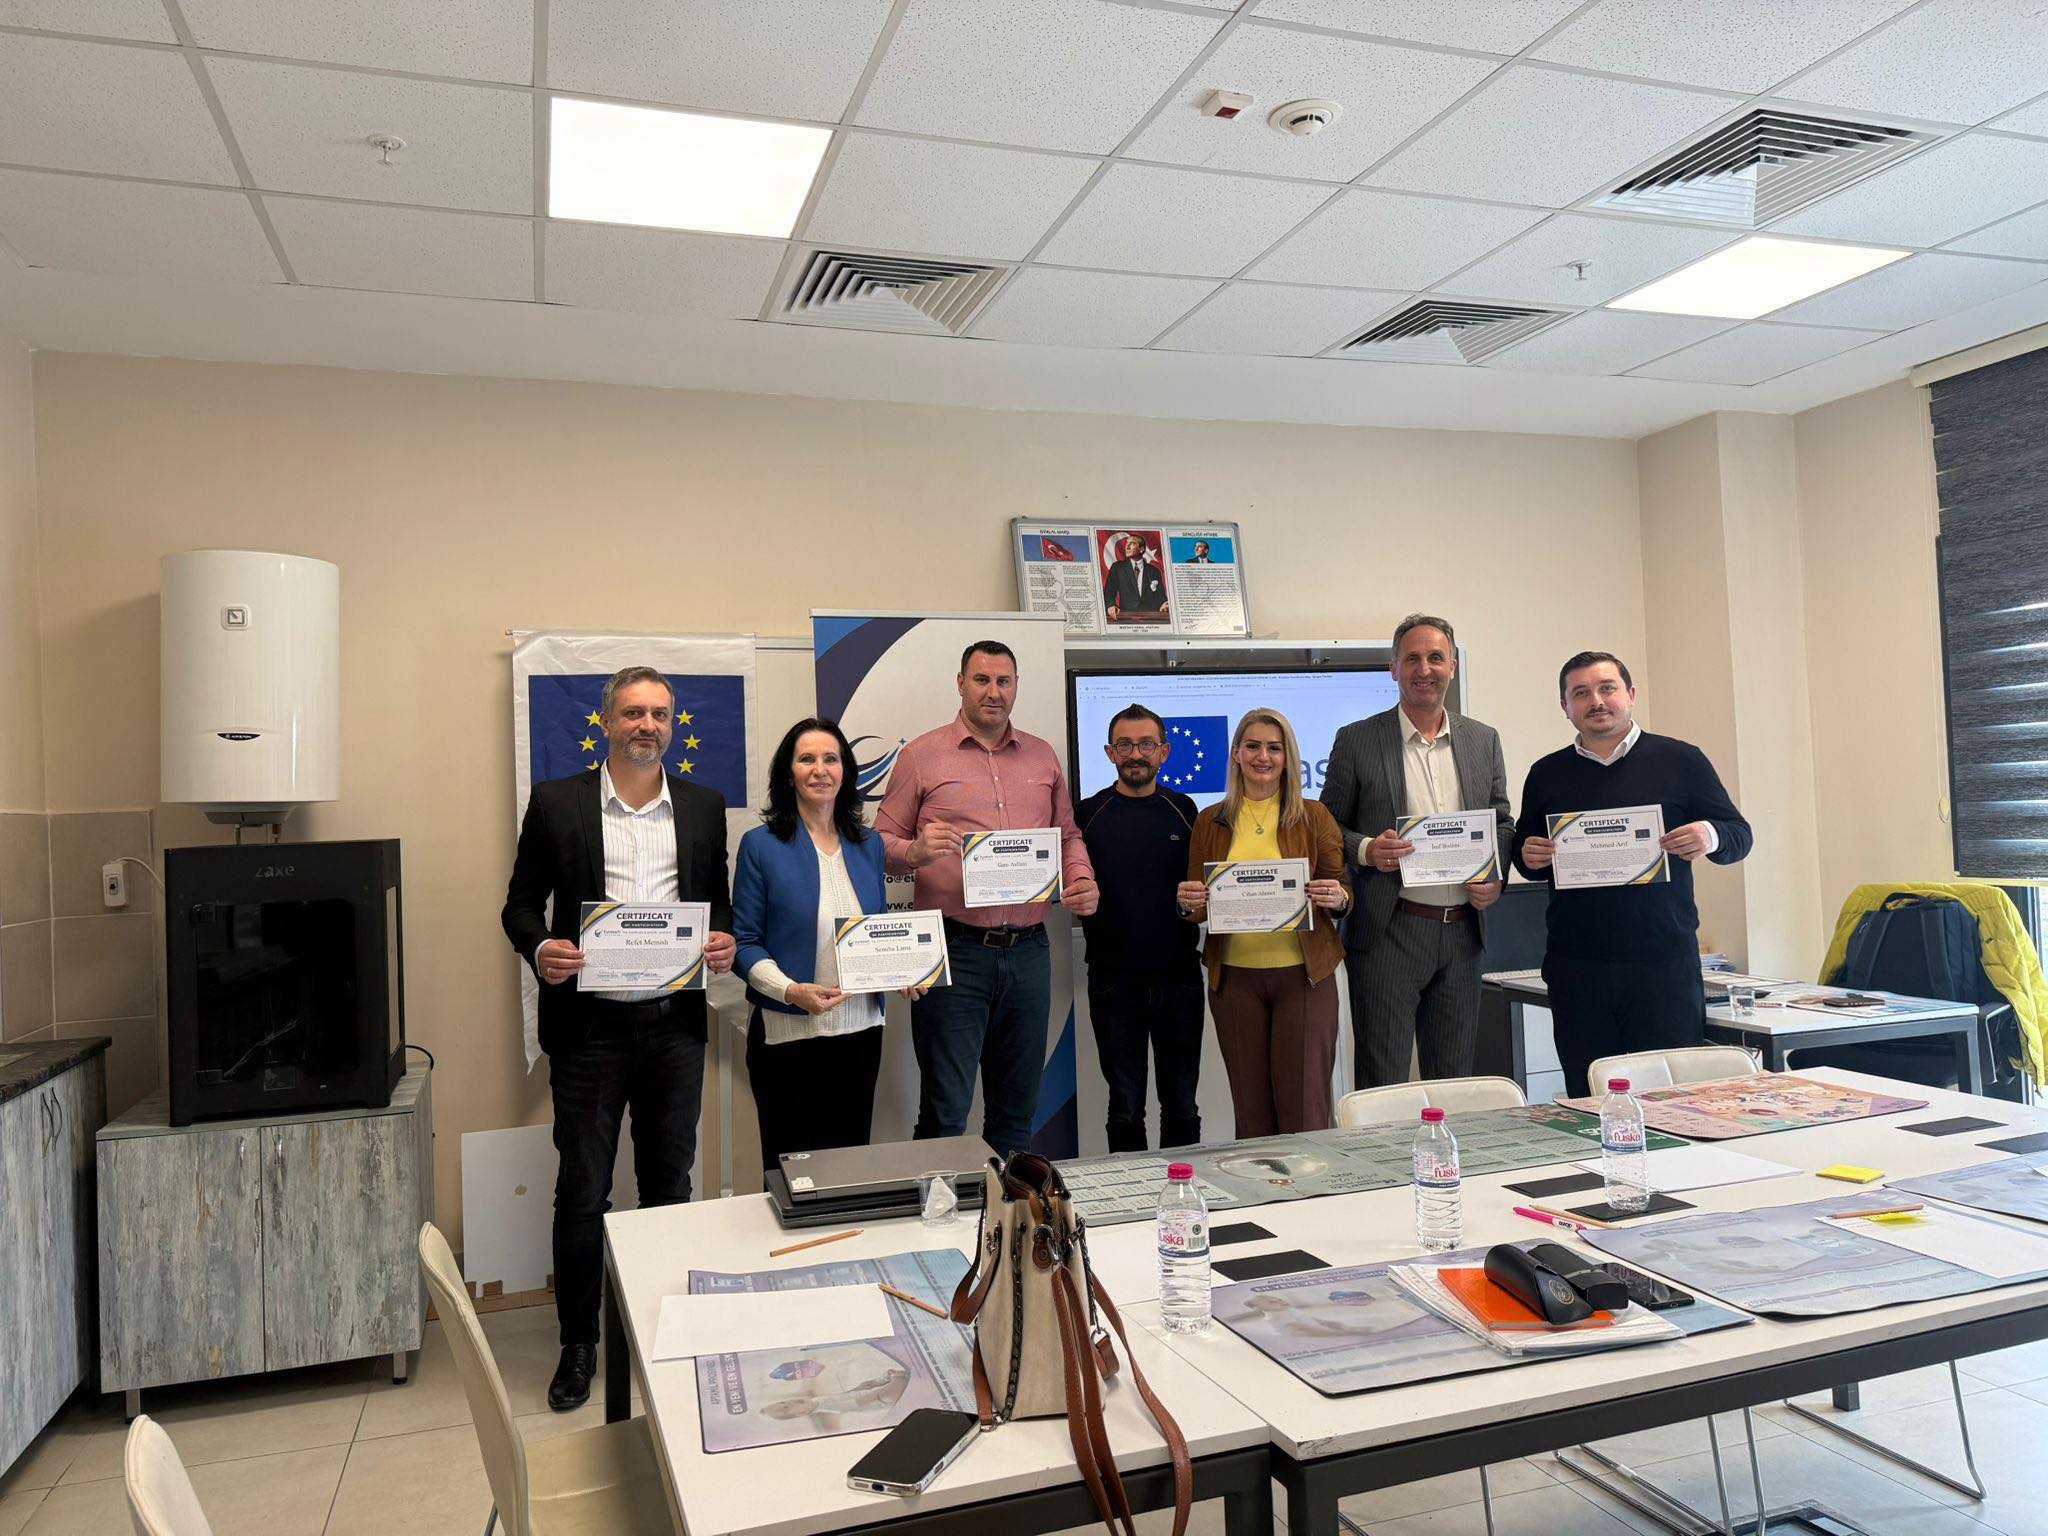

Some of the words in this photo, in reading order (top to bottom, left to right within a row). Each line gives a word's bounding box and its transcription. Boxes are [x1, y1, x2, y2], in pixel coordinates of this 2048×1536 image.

[1423, 821, 1467, 829] CERTIFICATE
[1579, 818, 1630, 827] CERTIFICATE
[864, 922, 912, 931] CERTIFICATE
[1614, 1132, 1640, 1142] fuska
